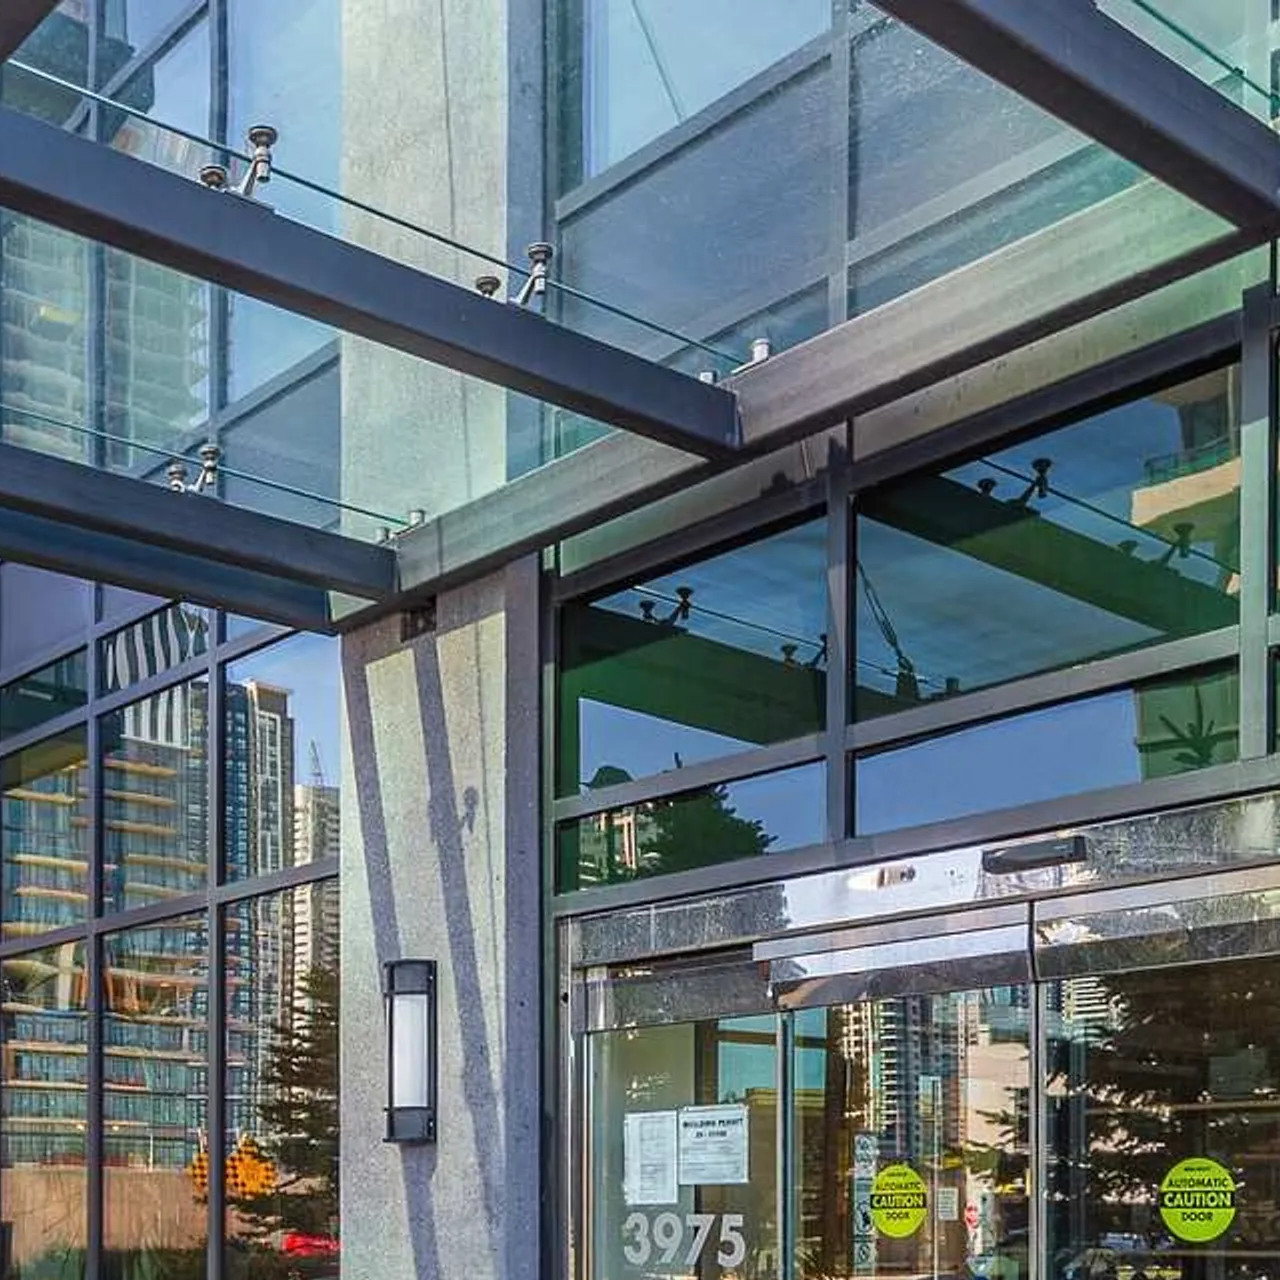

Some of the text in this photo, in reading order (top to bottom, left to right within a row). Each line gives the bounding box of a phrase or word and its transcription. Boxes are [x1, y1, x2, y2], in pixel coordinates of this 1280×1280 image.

[1168, 1178, 1229, 1188] AUTOMATIC
[871, 1194, 923, 1207] CAUTION
[1163, 1192, 1232, 1207] CAUTION
[1181, 1212, 1214, 1222] DOOR
[622, 1212, 746, 1267] 3975
